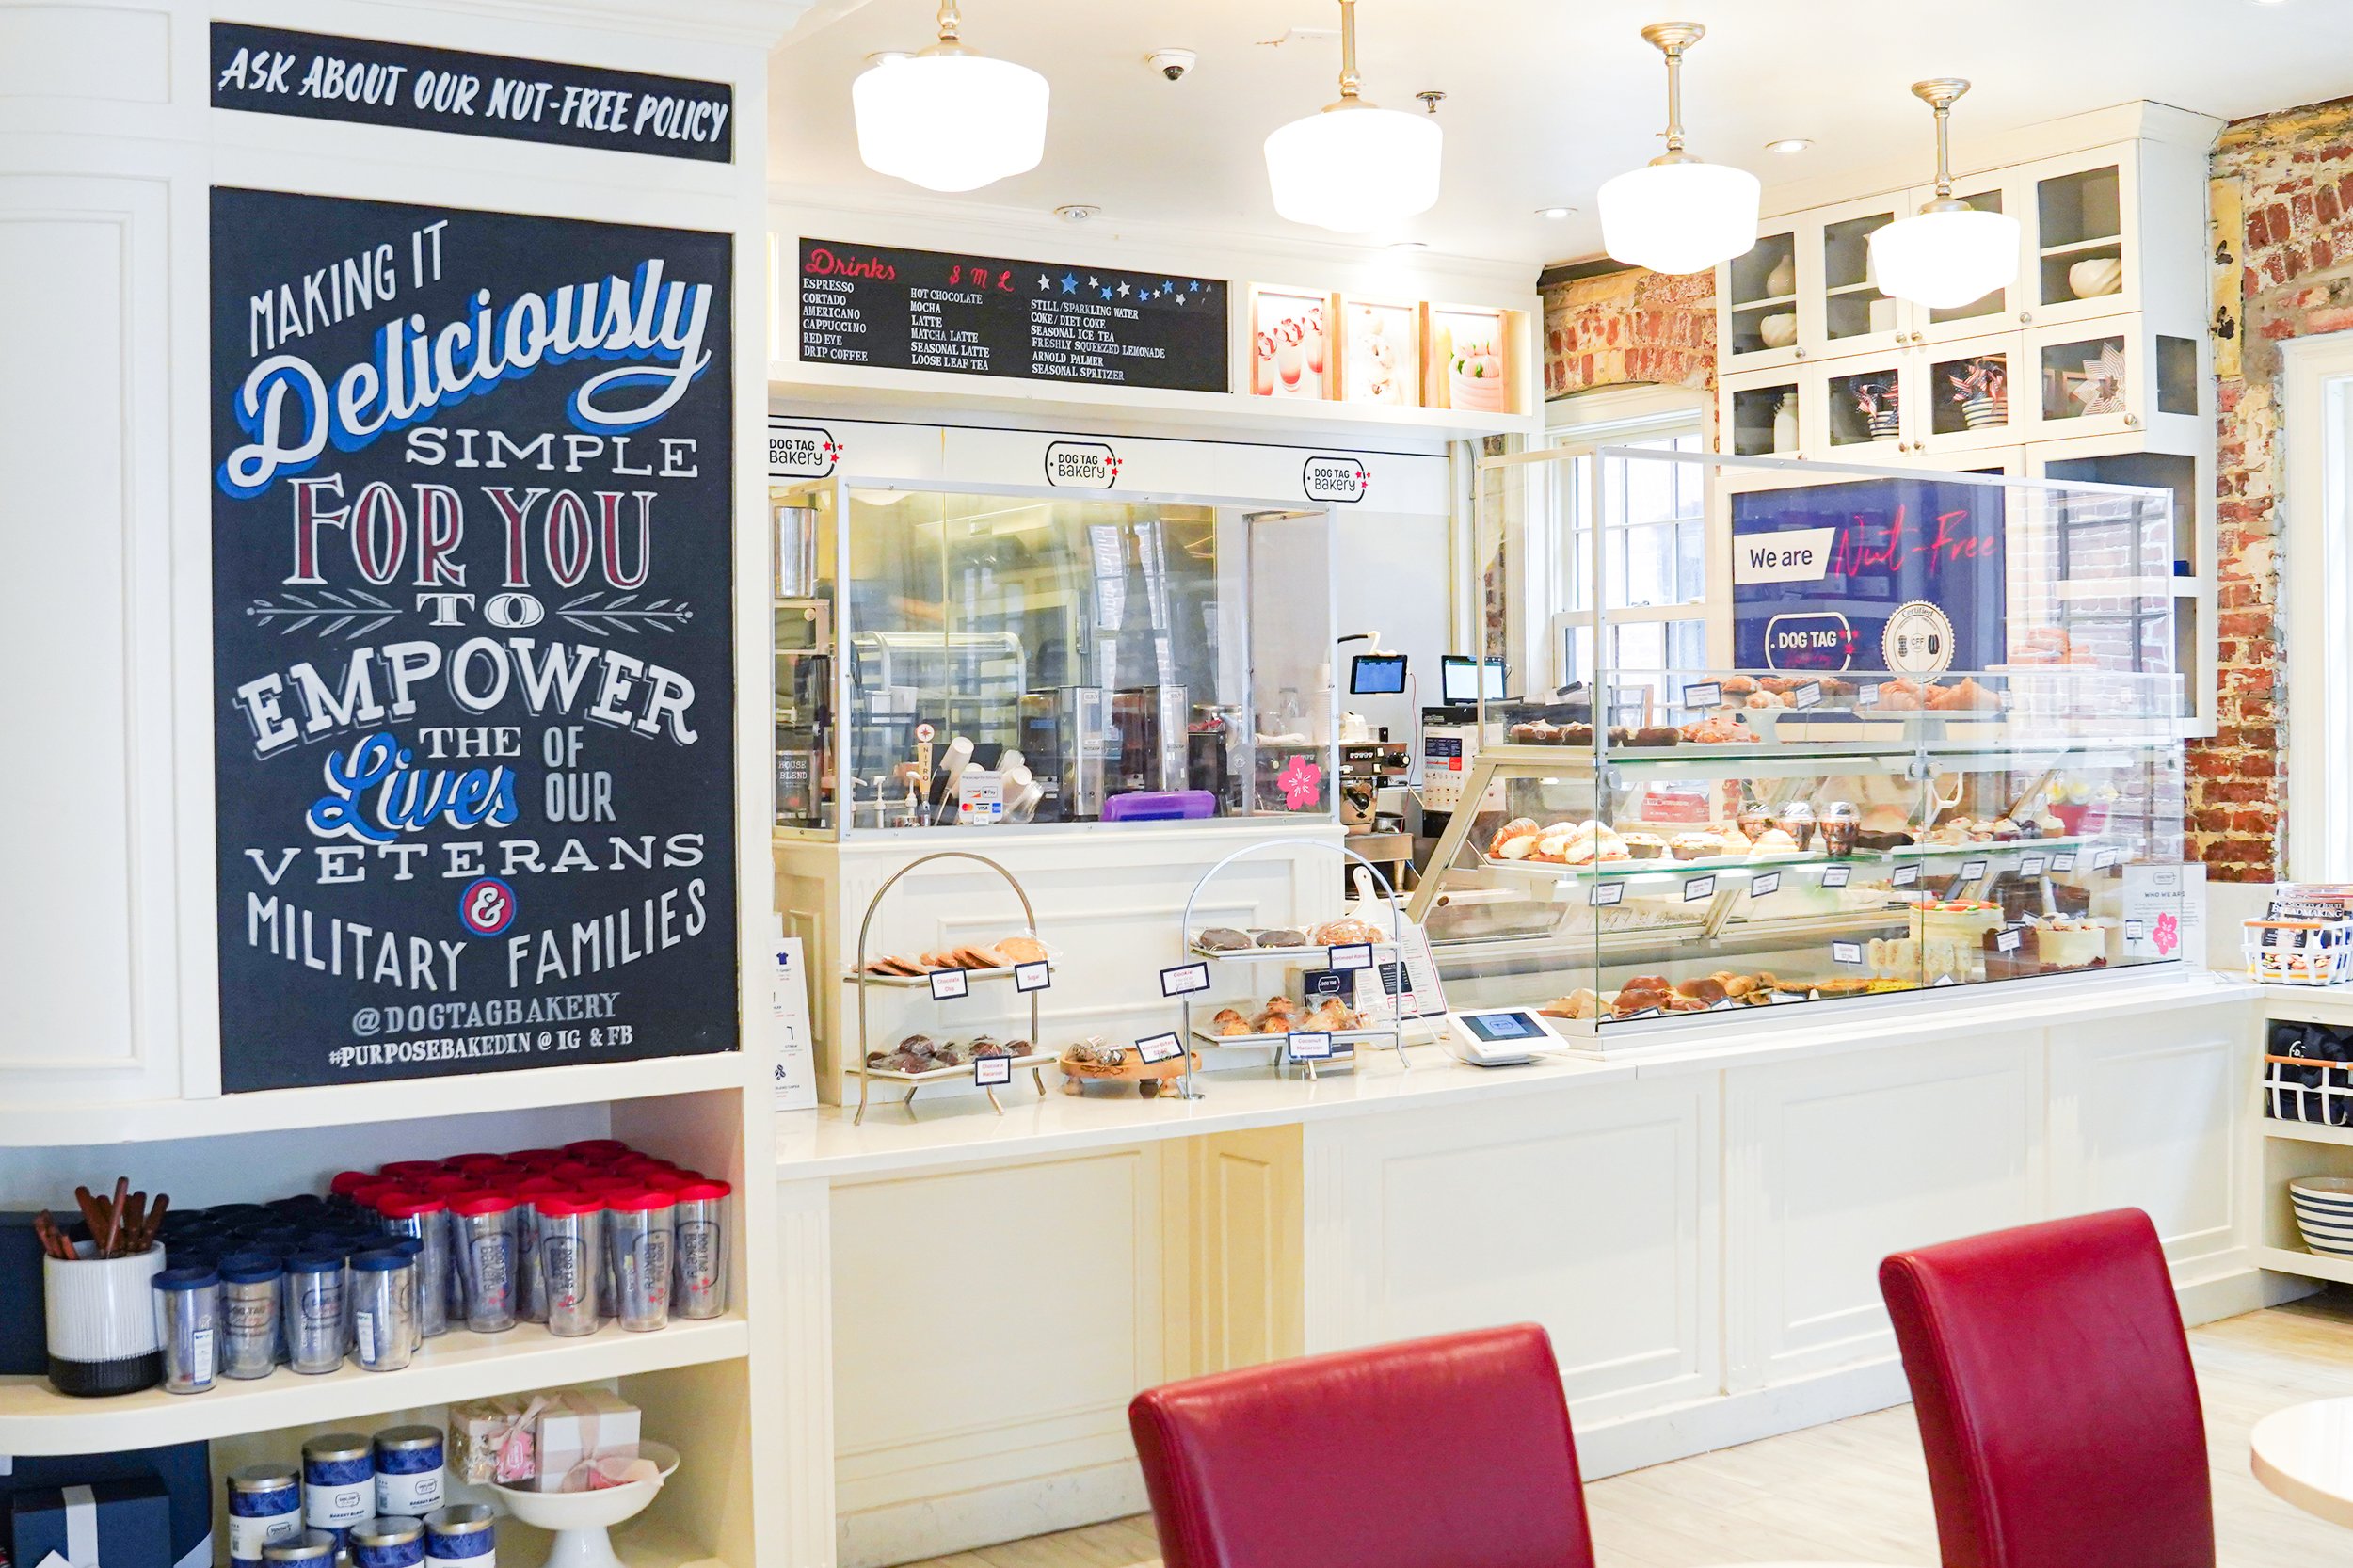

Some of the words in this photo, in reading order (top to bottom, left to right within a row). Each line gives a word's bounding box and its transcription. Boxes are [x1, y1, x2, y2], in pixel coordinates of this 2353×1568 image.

[217, 47, 296, 93] ASK
[301, 56, 407, 107] ABOUT
[414, 69, 481, 116] OUR
[486, 77, 632, 134] NUT-FREE
[633, 94, 729, 143] POLICY
[804, 248, 897, 280] Drinks
[803, 277, 855, 294] ESPRESSO
[949, 264, 961, 287] S
[970, 267, 988, 290] M
[997, 269, 1016, 293] L
[249, 244, 397, 358] MAKING
[411, 219, 449, 289] IT
[910, 287, 929, 300] HOT
[930, 289, 984, 305] CHOCOLATE
[802, 292, 847, 307] CORTADO
[910, 300, 942, 313] MOCHA
[802, 306, 860, 320] AMERICANO
[1031, 298, 1112, 318] STILL/SPARKLING
[1113, 307, 1139, 320] WATER
[803, 318, 867, 334] CAPPUCCINO
[911, 314, 943, 328] LATTE
[1082, 316, 1106, 329] COKE
[803, 331, 822, 345] RED
[824, 334, 843, 347] EYE
[910, 328, 947, 342] MATCHA
[949, 330, 979, 344] LATTE
[1031, 325, 1075, 339] SEASONAL
[1077, 328, 1095, 341] ICE
[1097, 331, 1115, 343] TEA
[804, 345, 828, 359] DRIP
[830, 348, 869, 362] COFFEE
[910, 341, 959, 356] SEASONAL
[961, 344, 990, 359] LATTE
[1032, 337, 1071, 351] FRESHLY
[1074, 341, 1120, 355] SQUEEZED
[1122, 344, 1166, 359] LEMONADE
[911, 353, 942, 367] LOOSE
[943, 356, 968, 370] LEAF
[970, 359, 989, 371] TEA
[1032, 350, 1066, 363] ARNOLD
[1070, 353, 1104, 367] PALMER
[220, 259, 713, 495] Deliciously
[1032, 363, 1078, 376] SEASONAL
[1080, 366, 1125, 381] SPRITZER
[406, 426, 698, 478] SIMPLE
[769, 439, 792, 451] DOG
[794, 440, 815, 452] TAG
[768, 450, 823, 467] Bakery
[1058, 453, 1080, 465] DOG
[1081, 454, 1098, 466] TAG
[1057, 464, 1106, 479] Bakery
[1314, 468, 1333, 479] DOG
[1334, 469, 1350, 479] TAG
[1314, 478, 1356, 492] Bakery
[283, 473, 466, 587] FOR
[481, 486, 658, 589] YOU
[1750, 548, 1777, 568] We
[1781, 549, 1813, 568] are
[416, 593, 546, 629] TO
[1778, 632, 1808, 648] DOG
[1809, 631, 1837, 648] TAG
[235, 637, 699, 756] EMPOWER
[418, 727, 522, 759] THE
[543, 725, 584, 768] OF
[778, 760, 807, 770] HOUSE
[779, 771, 808, 780] BLEND
[306, 732, 520, 845] Lives
[545, 771, 617, 823] OUR
[244, 834, 706, 886] VETERANS
[470, 886, 506, 928] &
[2271, 904, 2344, 918] BREADMAKING
[248, 892, 468, 992] MILITARY
[508, 878, 708, 989] FAMILIES
[351, 992, 620, 1036] @DOGTAGBAKERY
[328, 1032, 532, 1069] #PURPOSEBAKEDIN
[537, 1032, 552, 1051] @
[557, 1031, 581, 1051] IG
[589, 1028, 603, 1047] &
[606, 1025, 634, 1047] FB
